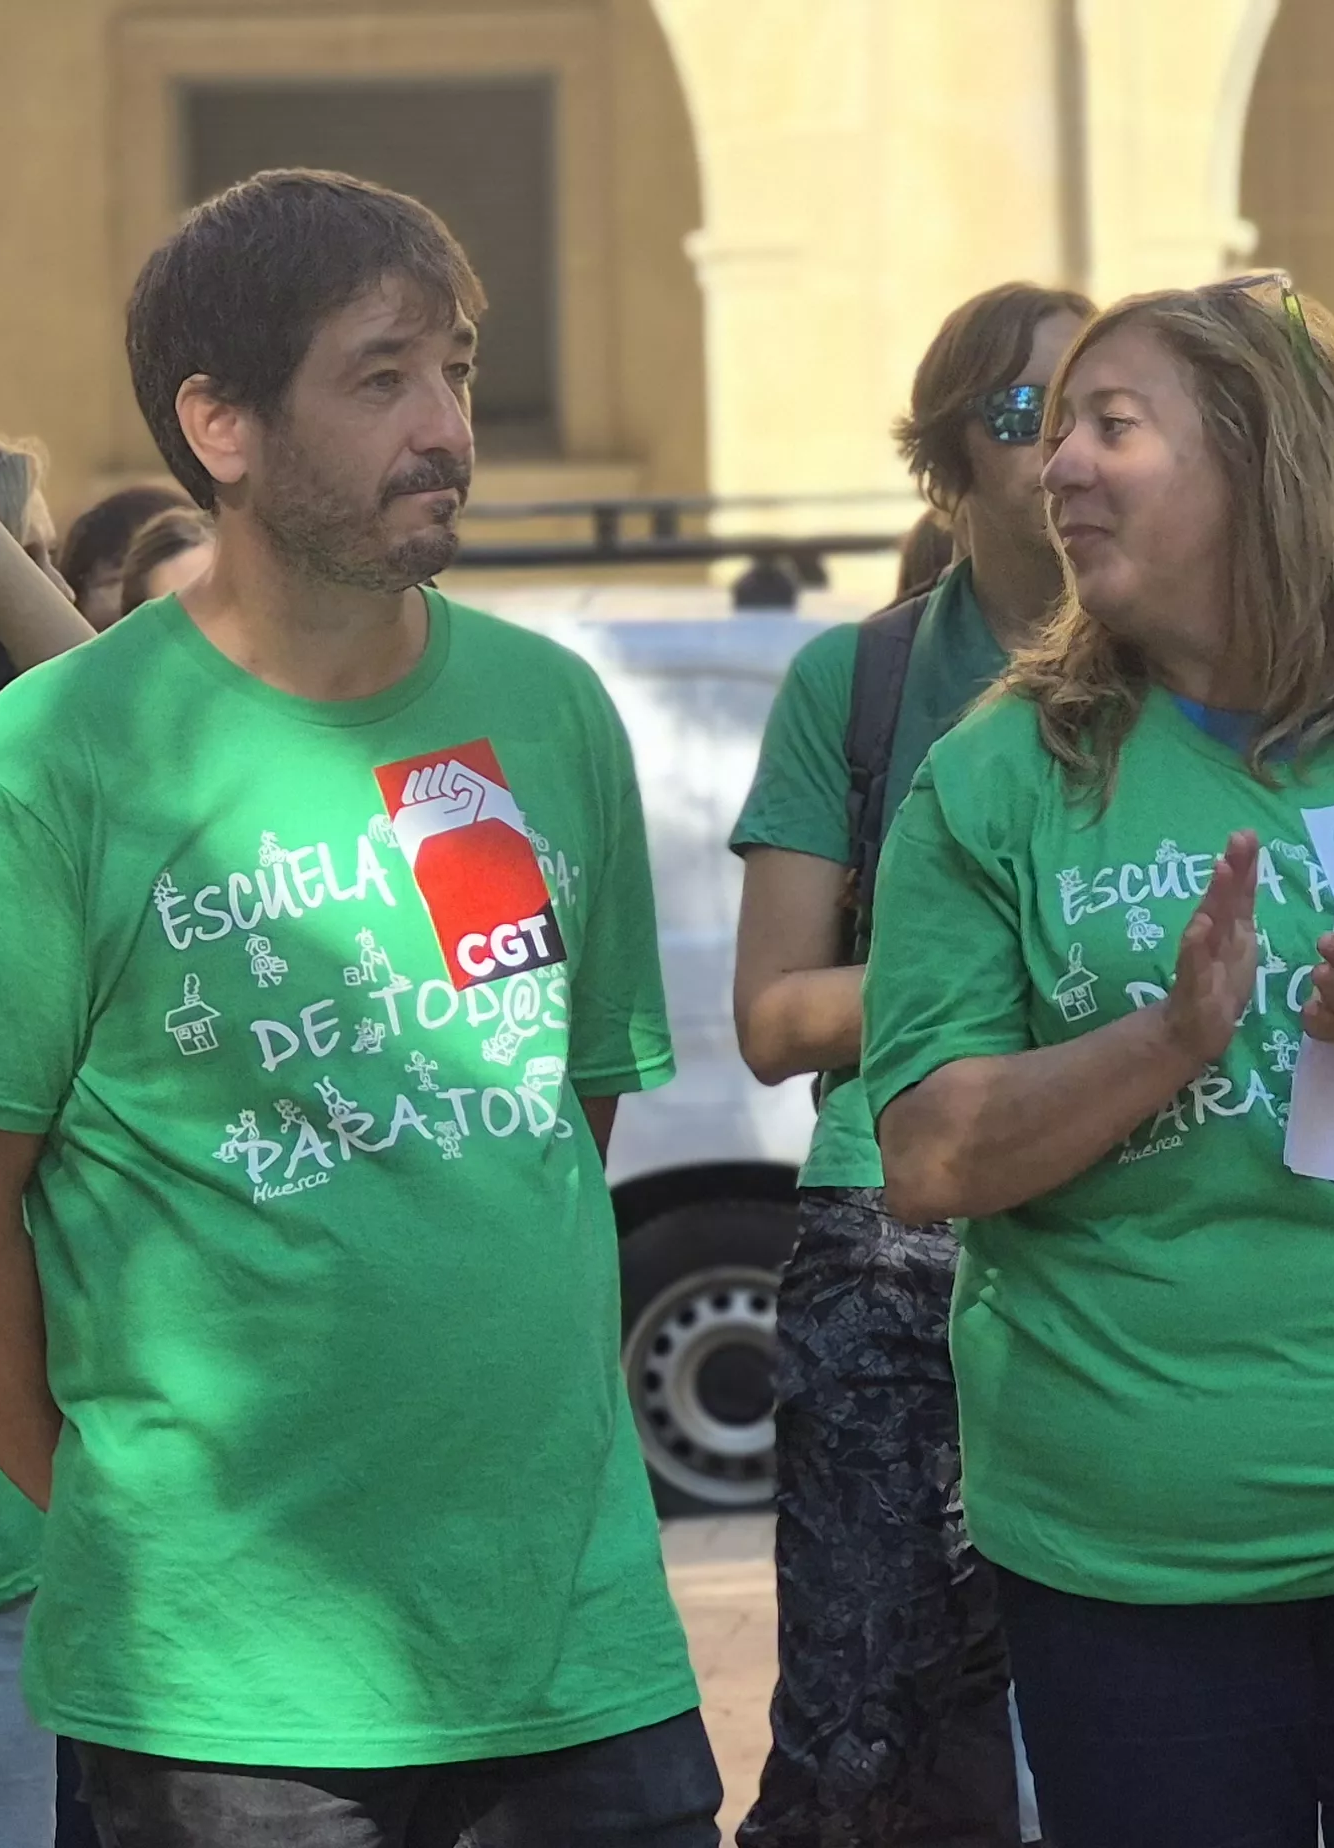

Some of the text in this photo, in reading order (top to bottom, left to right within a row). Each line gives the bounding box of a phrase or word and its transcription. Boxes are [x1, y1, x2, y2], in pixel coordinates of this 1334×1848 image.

[158, 834, 397, 950] ESCUELA
[1062, 847, 1287, 925] ESCUEA
[457, 914, 550, 977] CGT
[251, 999, 341, 1071] DE
[239, 1095, 433, 1183] PARA
[1149, 1069, 1277, 1138] ARA
[253, 1172, 331, 1204] Huesca
